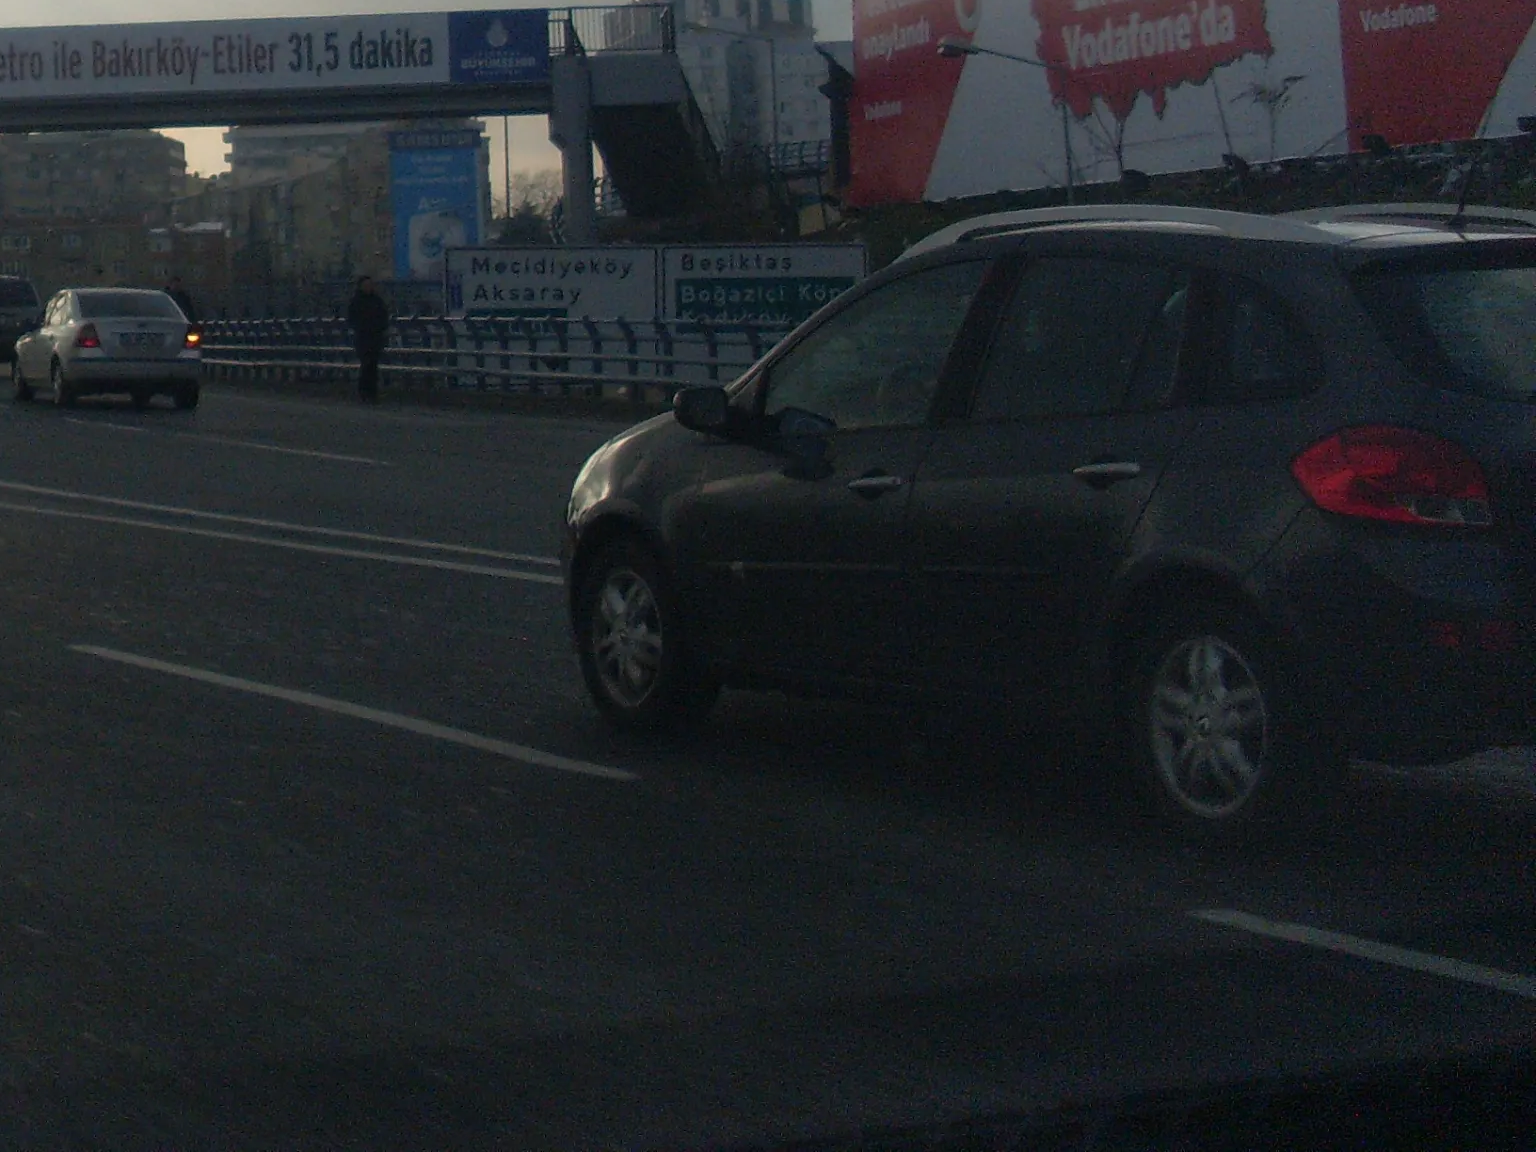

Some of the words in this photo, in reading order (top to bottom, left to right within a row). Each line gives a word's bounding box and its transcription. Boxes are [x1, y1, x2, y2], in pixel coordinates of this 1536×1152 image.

[1359, 3, 1438, 32] Vodafone
[53, 39, 82, 80] ile
[288, 30, 341, 76] 31,5
[349, 27, 434, 70] dakika
[473, 284, 582, 305] Aksaray
